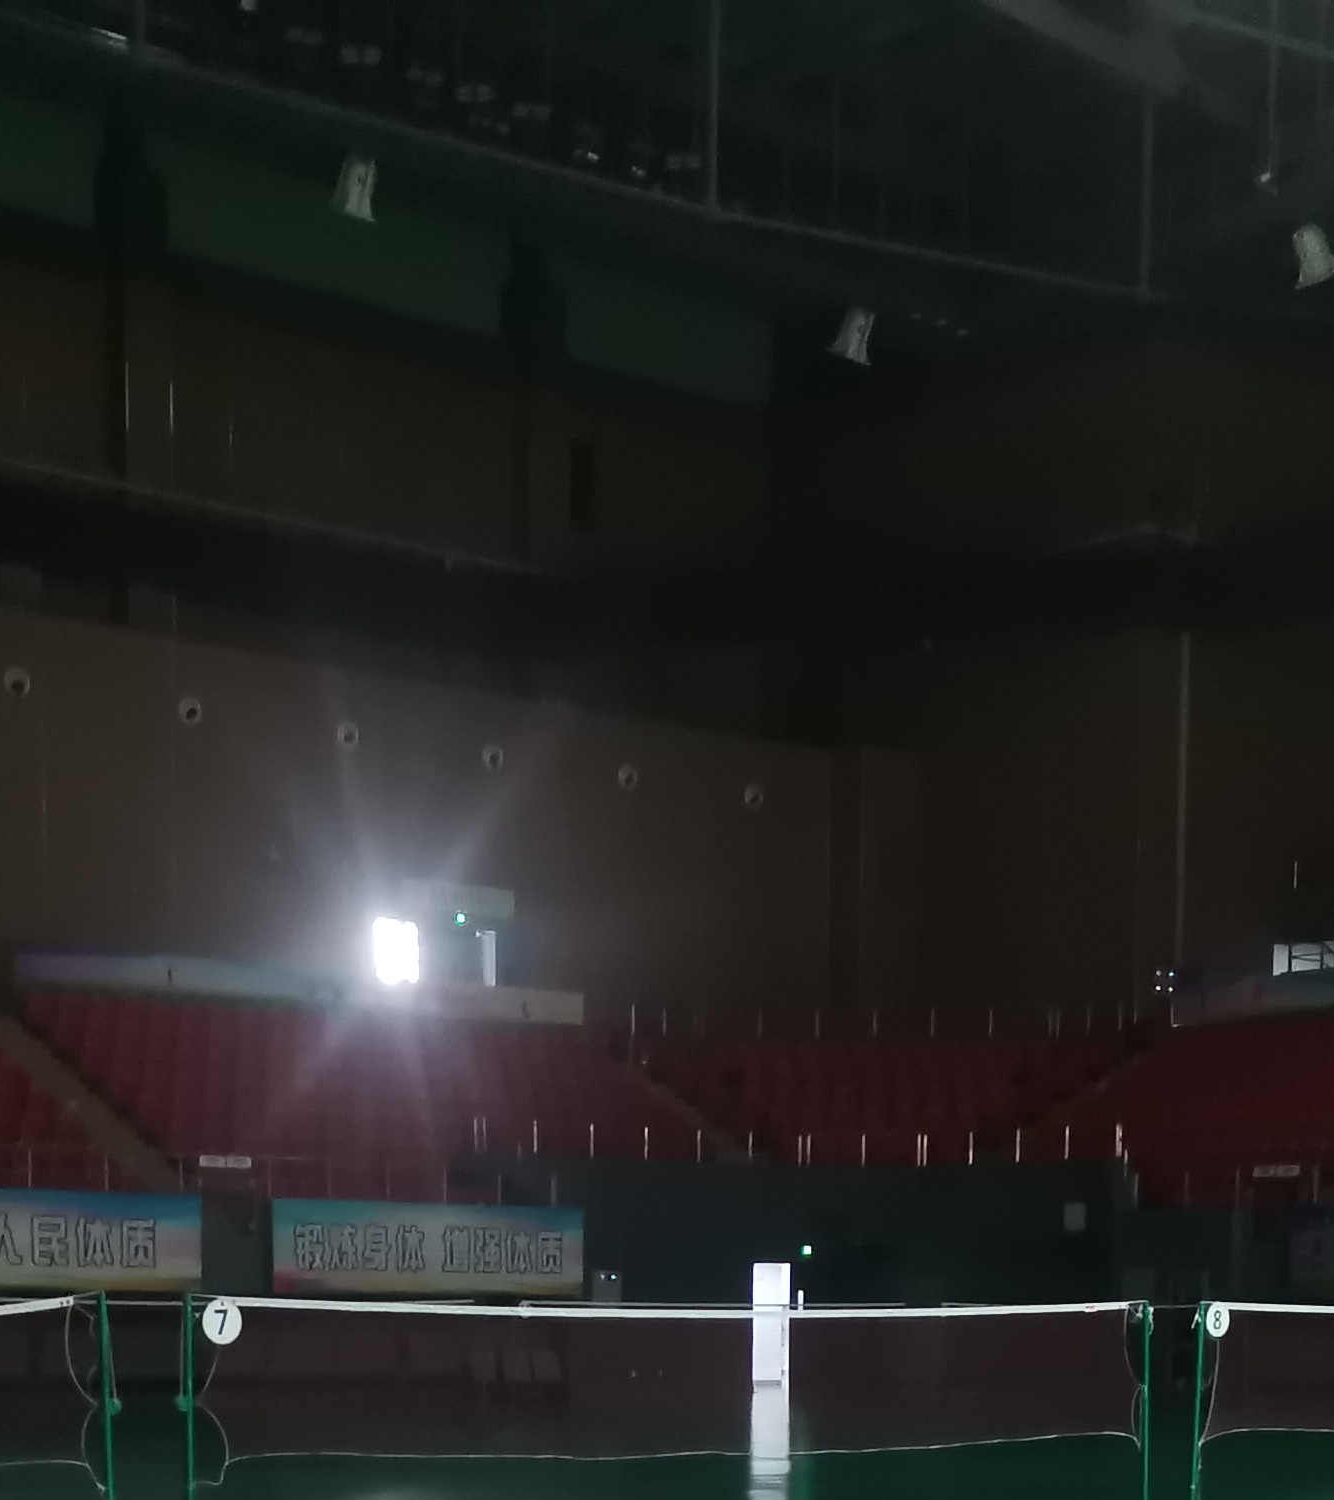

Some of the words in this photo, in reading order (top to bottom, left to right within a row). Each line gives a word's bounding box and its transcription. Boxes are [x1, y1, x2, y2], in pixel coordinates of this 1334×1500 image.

[293, 1223, 425, 1272] 锻炼身体
[442, 1225, 564, 1274] 增强体质
[214, 1309, 228, 1335] 7
[1213, 1310, 1221, 1329] 8
